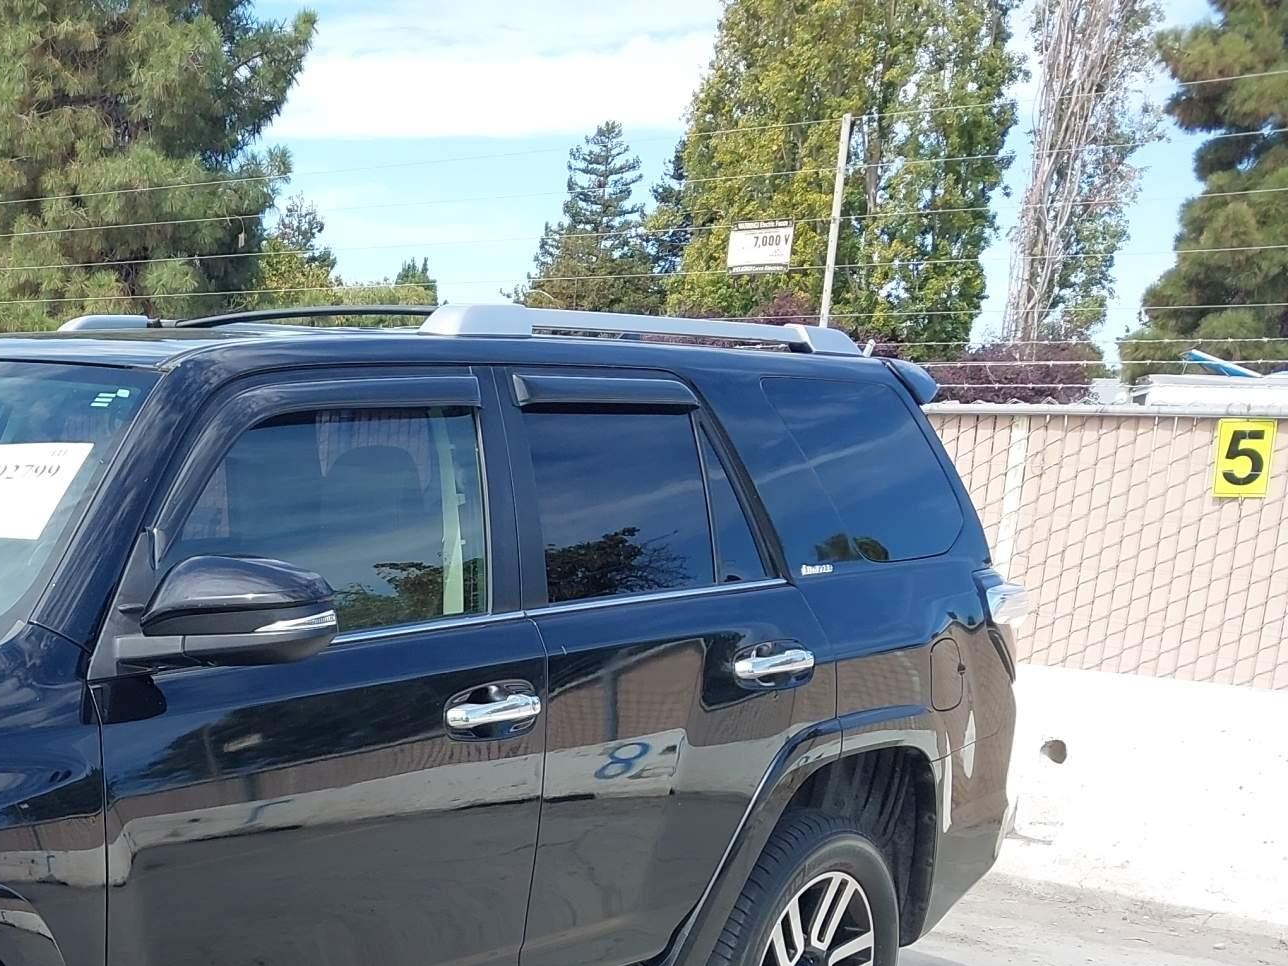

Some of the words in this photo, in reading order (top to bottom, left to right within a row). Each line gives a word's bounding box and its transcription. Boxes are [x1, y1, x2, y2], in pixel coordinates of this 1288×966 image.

[753, 234, 781, 248] 7,000
[784, 233, 790, 246] V
[1222, 429, 1265, 486] 5
